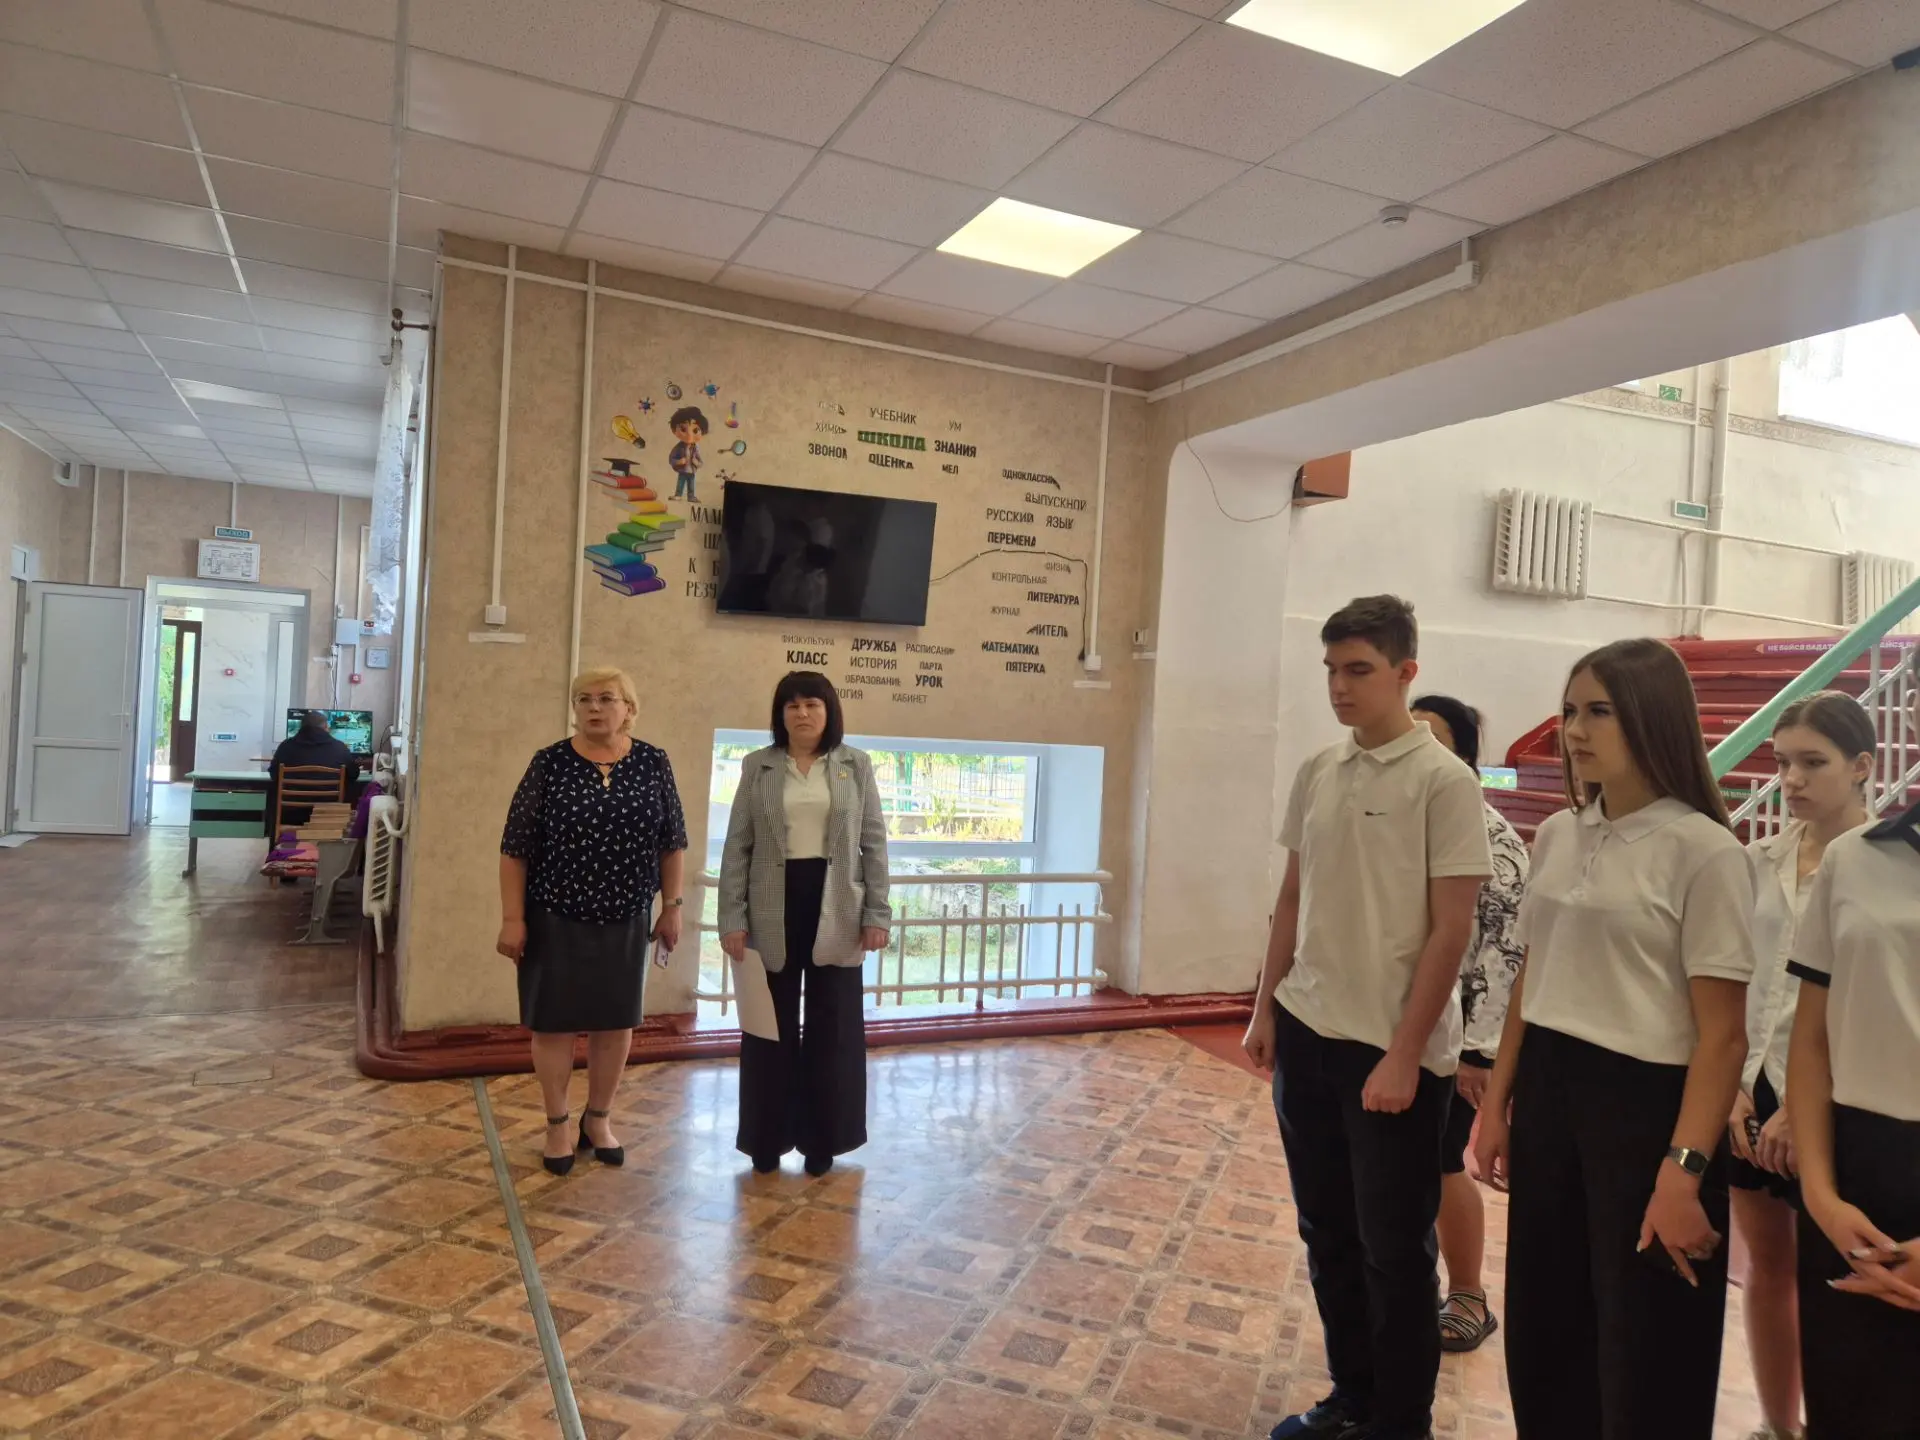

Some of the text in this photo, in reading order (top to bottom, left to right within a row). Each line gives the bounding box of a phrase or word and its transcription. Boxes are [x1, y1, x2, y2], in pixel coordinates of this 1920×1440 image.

[870, 407, 917, 425] УЧЕБНИК
[857, 430, 926, 452] ШКОЛА
[934, 439, 977, 458] ЗНАНИЯ
[987, 531, 1037, 547] ПЕРЕМЕНА
[1026, 590, 1080, 606] ЛИТЕРАТУРА
[781, 634, 835, 647] ФИЗКУЛЬТУРА
[850, 637, 897, 653] ДРУЖБА
[981, 640, 1040, 656] МАТЕМАТИКА
[786, 650, 829, 666] КЛАСС
[850, 656, 897, 670] ИСТОРИЯ
[920, 661, 943, 672] ПАРТА
[1005, 661, 1046, 674] ПЯТЕРКА
[915, 674, 943, 689] УРОК
[892, 693, 929, 704] КАБИНЕТ
